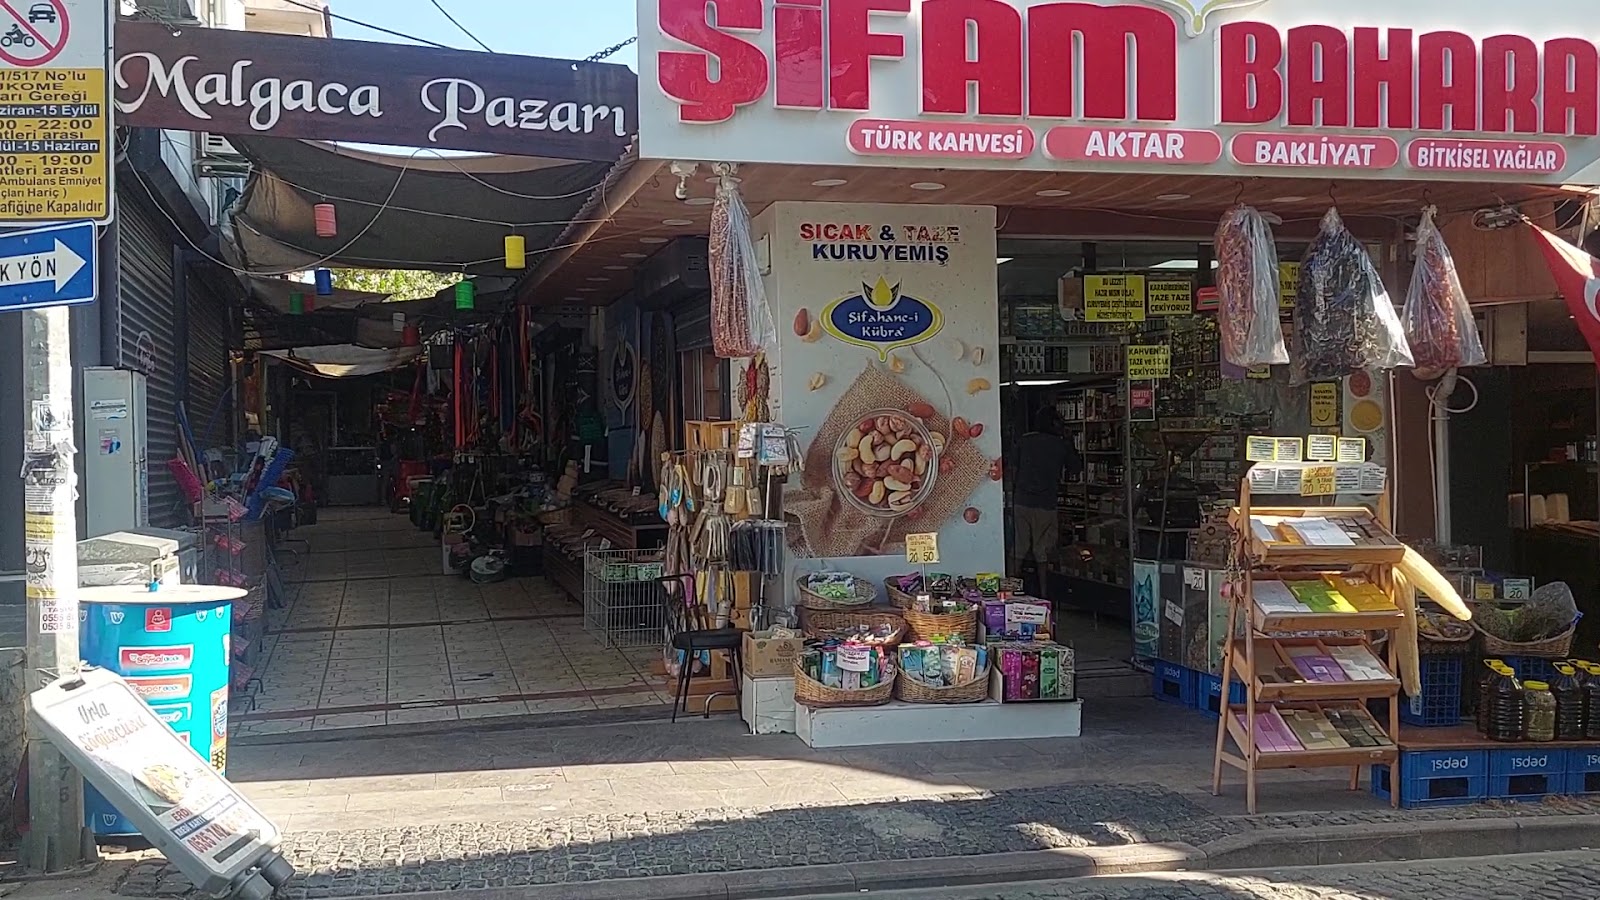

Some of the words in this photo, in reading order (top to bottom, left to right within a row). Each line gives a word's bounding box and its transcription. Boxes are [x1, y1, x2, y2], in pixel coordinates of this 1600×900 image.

[657, 0, 1178, 125] ŞİFAM
[29, 90, 87, 103] Gereği
[114, 52, 383, 131] Malgaca
[420, 77, 626, 142] Pazarı
[61, 104, 97, 117] Eylül
[38, 119, 92, 130] 22:00
[42, 131, 84, 140] arası
[861, 124, 922, 151] TÜRK
[928, 128, 1023, 154] KAHVESİ
[44, 141, 98, 151] Haziran
[1085, 130, 1184, 159] AKTAR
[1255, 137, 1375, 166] BAKLİYAT
[1417, 142, 1490, 169] BİTKİSEL
[1493, 145, 1557, 170] YAĞLAR
[39, 155, 93, 165] 19:00
[43, 166, 84, 175] arası
[59, 176, 102, 188] Emniyet
[27, 188, 59, 198] Hariç
[47, 199, 102, 215] Kapalıdır
[800, 223, 873, 242] SICAK
[879, 225, 896, 242] &
[812, 242, 949, 266] KURUYEMİŞ
[17, 256, 56, 280] YÖN
[1150, 294, 1169, 302] TAZE
[1171, 294, 1190, 302] TAZE
[1150, 303, 1190, 313] ÇEKİYORUZ
[1129, 358, 1142, 366] TAZE
[1303, 483, 1314, 495] 20
[1319, 483, 1331, 494] 50
[923, 551, 934, 562] 50
[1509, 590, 1523, 599] 20
[1431, 756, 1469, 771] pepsi
[1511, 755, 1548, 770] pepsi
